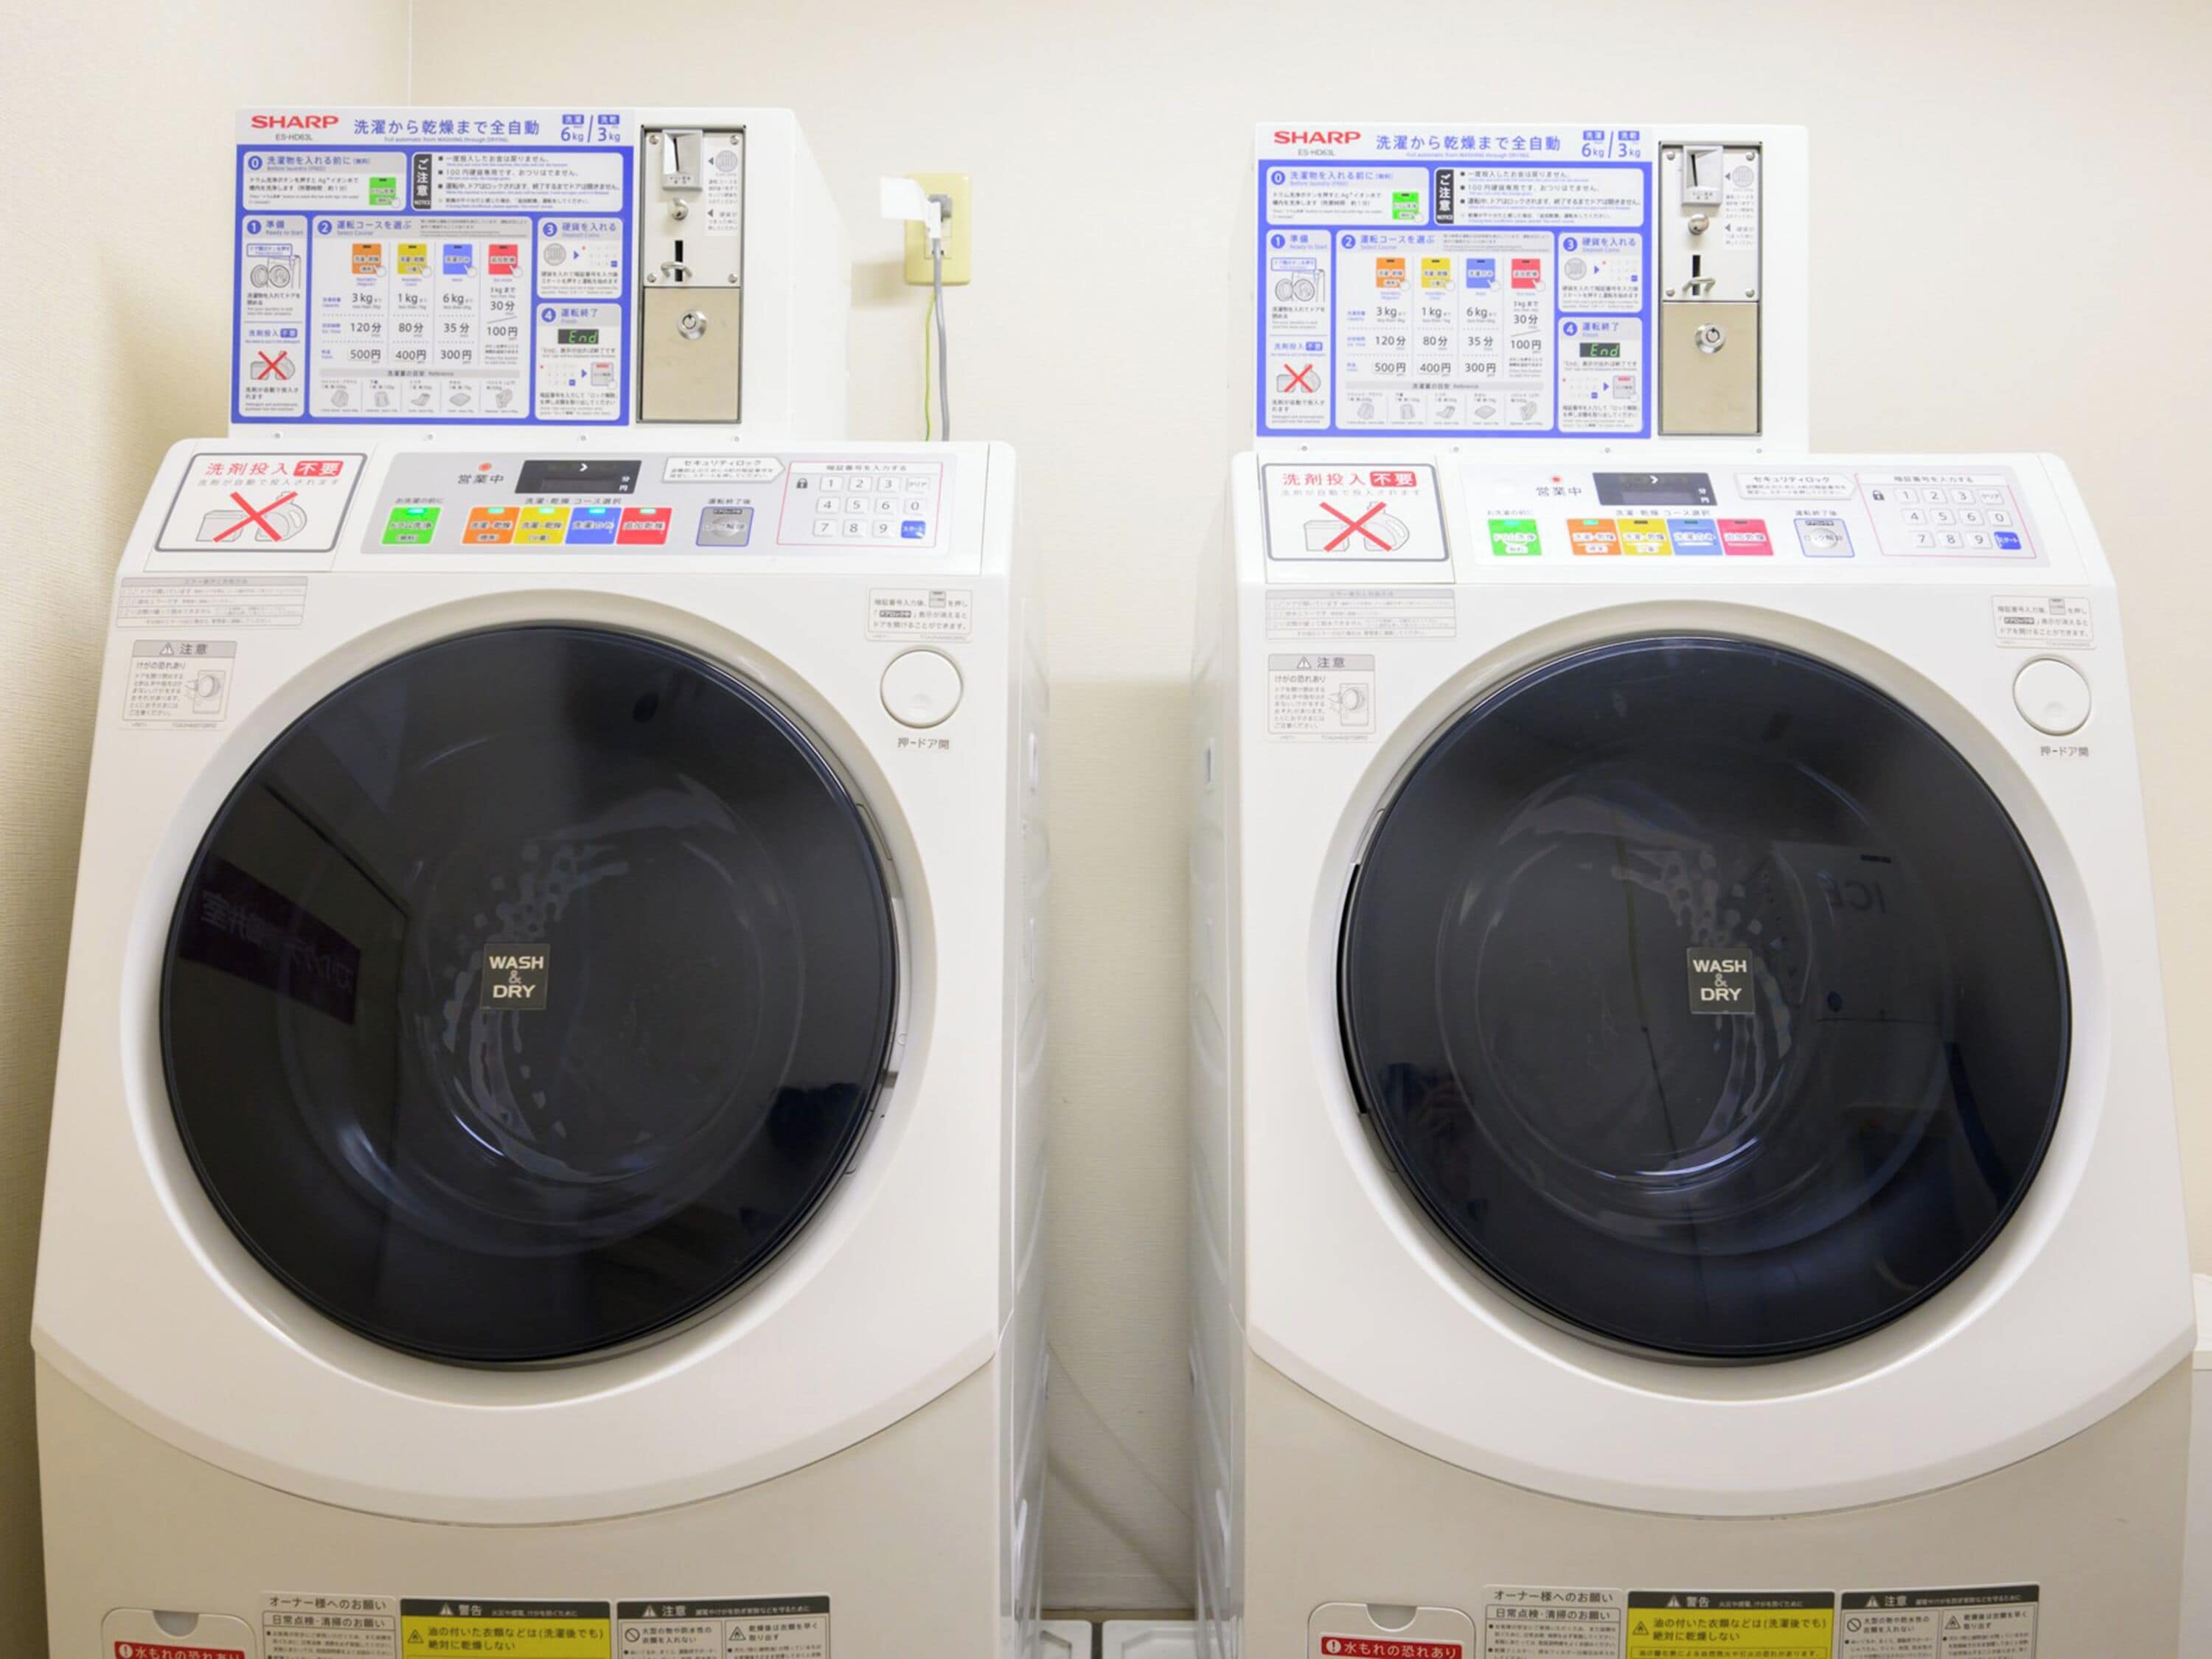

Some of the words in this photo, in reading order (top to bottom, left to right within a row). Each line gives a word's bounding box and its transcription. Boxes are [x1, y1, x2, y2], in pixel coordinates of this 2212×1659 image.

[251, 116, 338, 128] SHARP
[354, 119, 540, 136] 洗濯から乾燥まで全自動
[1274, 131, 1360, 144] SHARP
[1377, 136, 1560, 151] 洗濯から乾燥まで全自動
[267, 156, 350, 165] 洗濯物を入れる前に
[417, 158, 428, 196] ご注意
[1290, 171, 1374, 180] 洗濯物を入れる前に
[1439, 173, 1451, 211] ご注意
[337, 221, 411, 229] 運転コースを選ぶ
[1290, 235, 1308, 243] 準備
[1361, 235, 1435, 243] 運転コースを選ぶ
[351, 323, 381, 332] 120分
[399, 323, 423, 332] 80分
[444, 324, 469, 333] 35分
[487, 327, 518, 335] 100円
[1582, 322, 1619, 331] 運転終了
[568, 332, 598, 343] End
[1376, 336, 1405, 346] 120分
[1423, 336, 1447, 346] 80分
[1468, 337, 1493, 346] 35分
[1511, 340, 1541, 349] 100円
[350, 349, 380, 360] 500円
[396, 350, 426, 360] 400円
[441, 350, 471, 360] 300円
[1590, 345, 1619, 356] End
[1375, 363, 1406, 372] 500円
[1420, 364, 1450, 372] 400円
[1465, 364, 1495, 372] 300円
[206, 462, 288, 476] 洗剤投入
[297, 462, 341, 475] 不要
[458, 474, 504, 484] 営業中
[1283, 473, 1365, 485] 洗剤投入
[1373, 473, 1414, 486] 不要
[856, 480, 863, 488] 2
[885, 480, 891, 488] 3
[1537, 487, 1582, 496] 営業中
[1931, 492, 1938, 500] 2
[1958, 492, 1966, 500] 3
[854, 501, 860, 509] 5
[882, 501, 889, 509] 6
[911, 502, 919, 510] 0
[1939, 512, 1947, 521] 5
[1967, 513, 1975, 521] 6
[1995, 514, 2004, 522] 0
[822, 524, 829, 532] 7
[850, 524, 858, 532] 8
[880, 524, 887, 533] 9
[1947, 535, 1955, 543] 8
[1975, 536, 1983, 544] 9
[180, 644, 208, 655] 注意
[136, 661, 186, 669] けがの恐れあり
[1318, 657, 1345, 668] 注意
[490, 956, 544, 970] WASH
[1693, 960, 1747, 973] WASH
[509, 970, 521, 984] &
[1714, 973, 1728, 987] &
[493, 984, 536, 998] DRY
[1700, 988, 1742, 1001] DRY
[1494, 1591, 1613, 1604] オーナー様へのお願い
[1686, 1596, 1709, 1607] 警告
[1885, 1596, 1907, 1607] 注意
[270, 1597, 386, 1611] オーナー様へのお願い
[459, 1604, 482, 1616] 警告
[662, 1605, 686, 1616] 注意
[1496, 1608, 1610, 1621] 日常点検・清掃のお願い
[1863, 1625, 1915, 1633] 衣類を入れない
[642, 1636, 696, 1644] 衣類を入れない
[1653, 1631, 1739, 1641] 絶対に乾燥しない
[428, 1641, 515, 1651] 絶対に乾燥しない
[1344, 1642, 1457, 1659] 水もれの恐れあり
